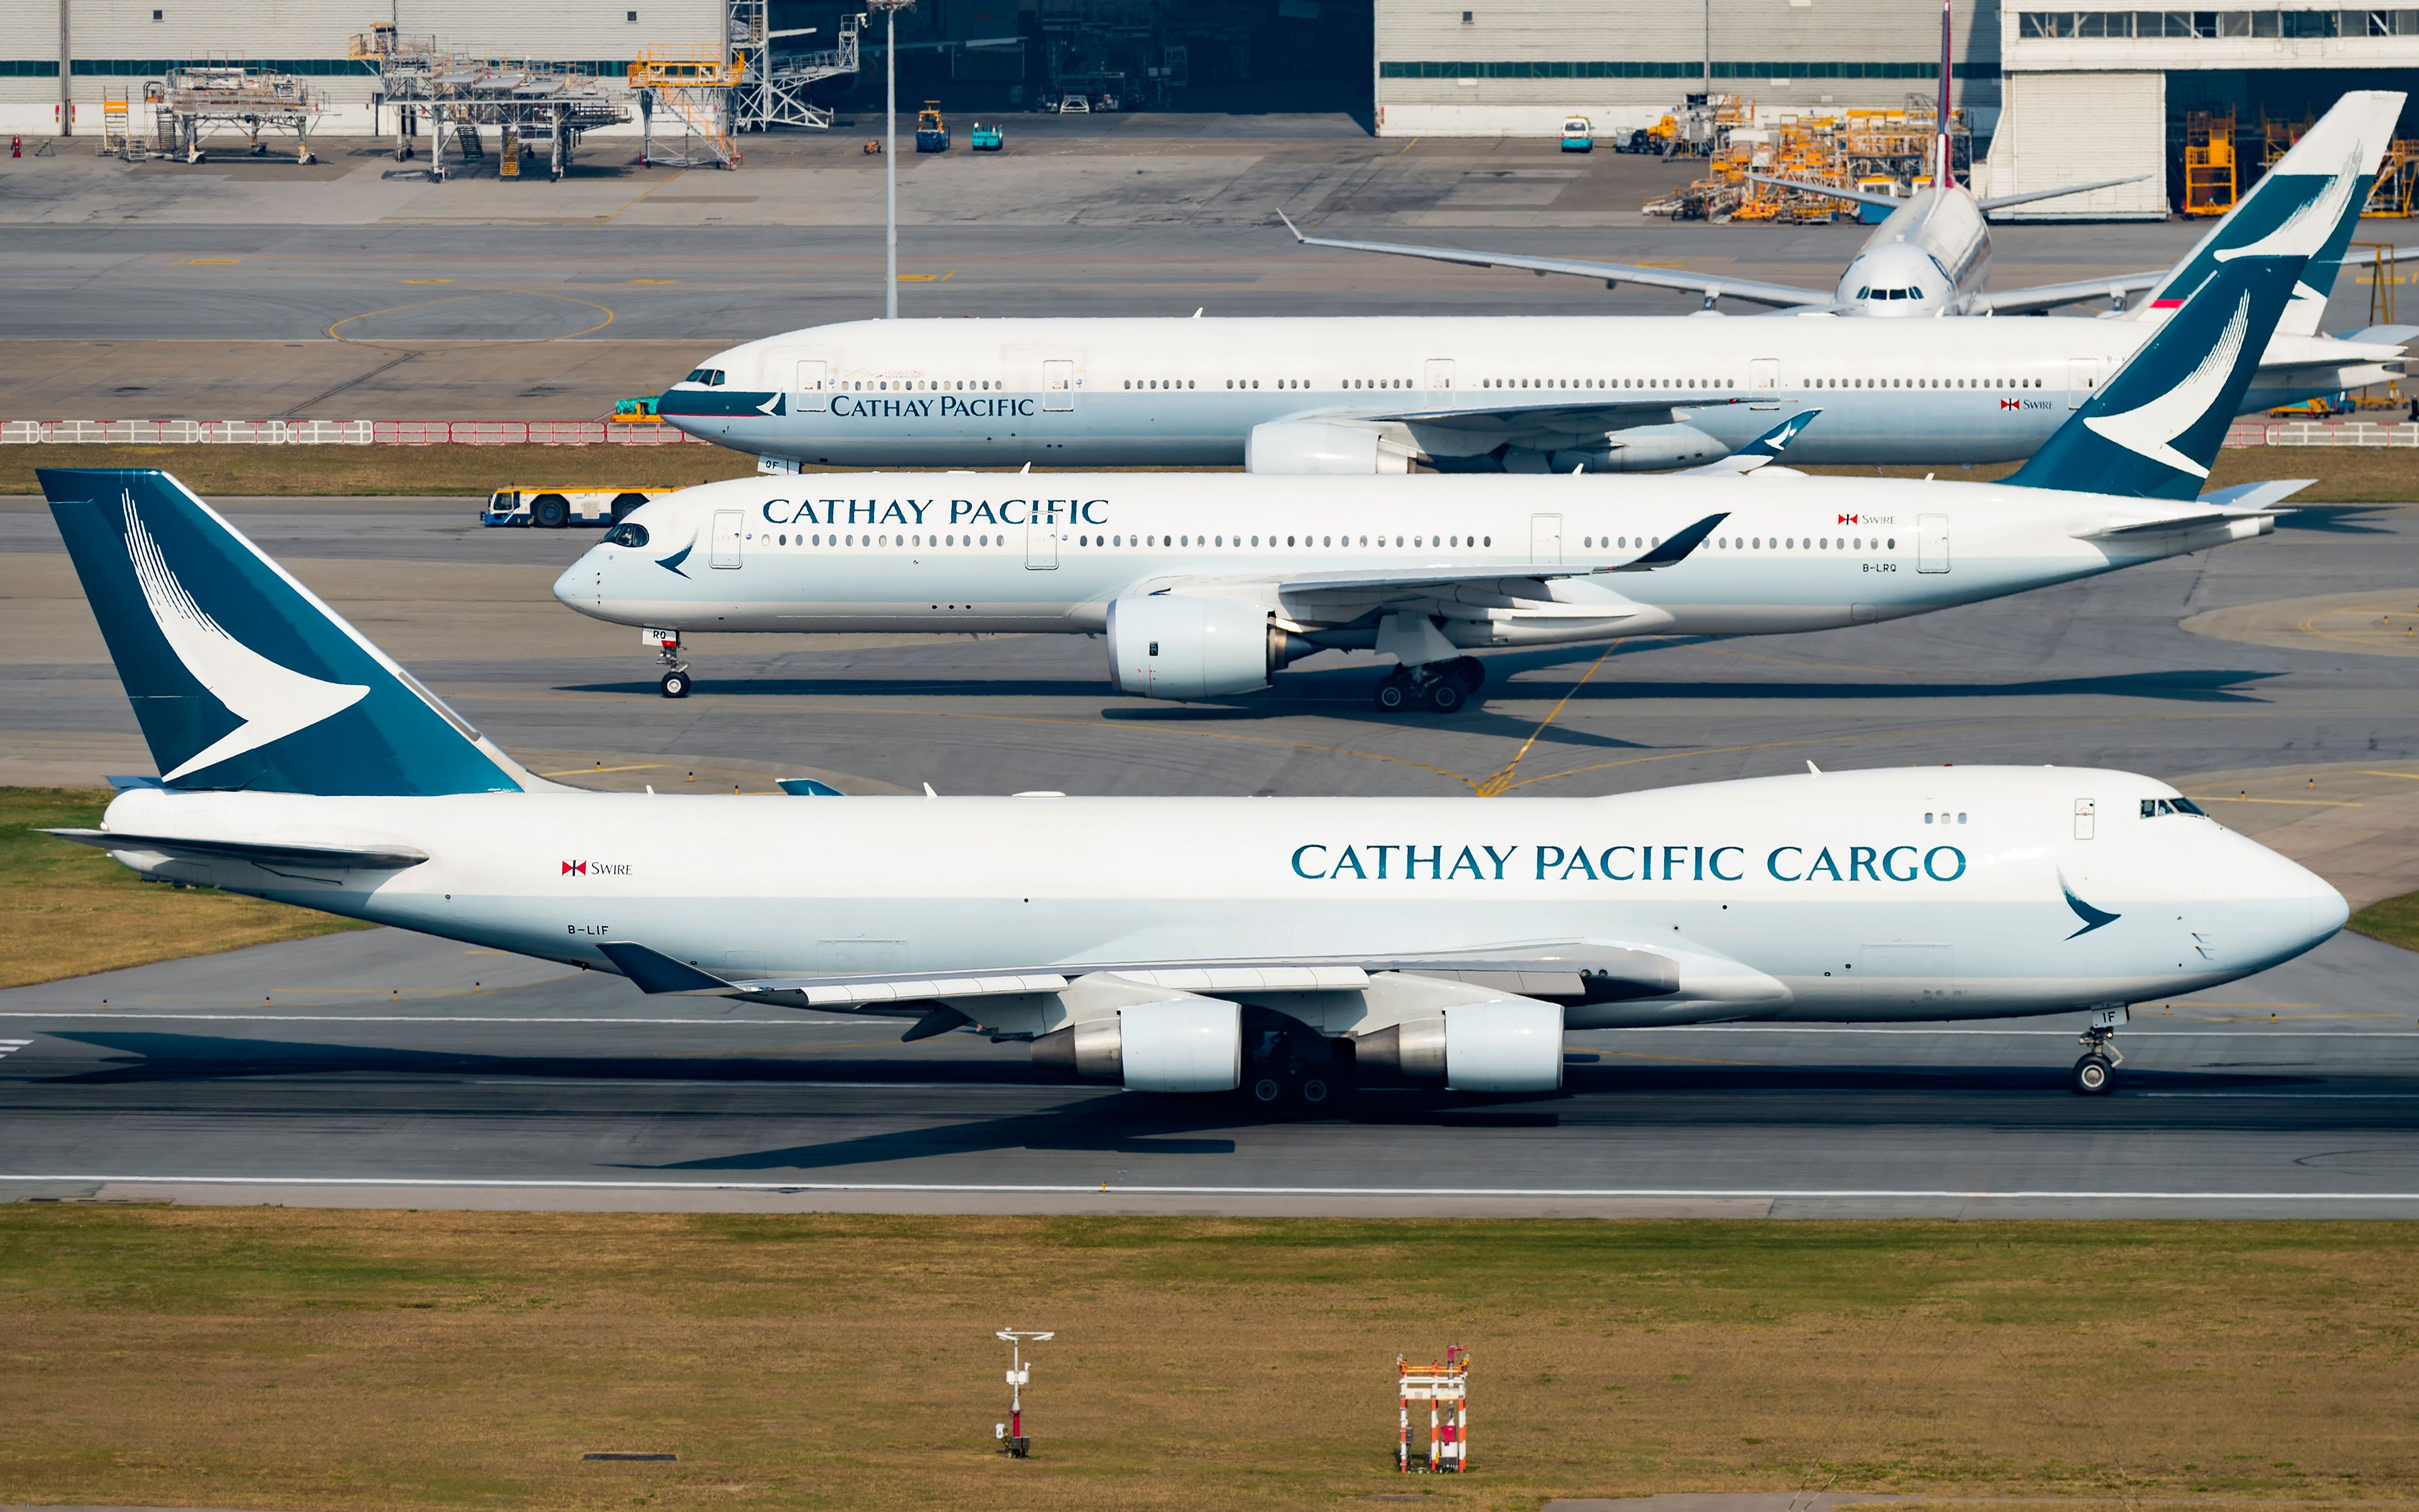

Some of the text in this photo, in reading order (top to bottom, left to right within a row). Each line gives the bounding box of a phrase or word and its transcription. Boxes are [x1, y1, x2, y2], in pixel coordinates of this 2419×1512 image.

[830, 395, 1034, 417] CATHAY PACIFIC
[763, 499, 1109, 525] CATHAY PACIFIC
[1863, 564, 1896, 572] B-LRQ
[1291, 844, 1966, 882] CATHAY PACIFIC CARGO
[567, 925, 608, 935] B-LIF
